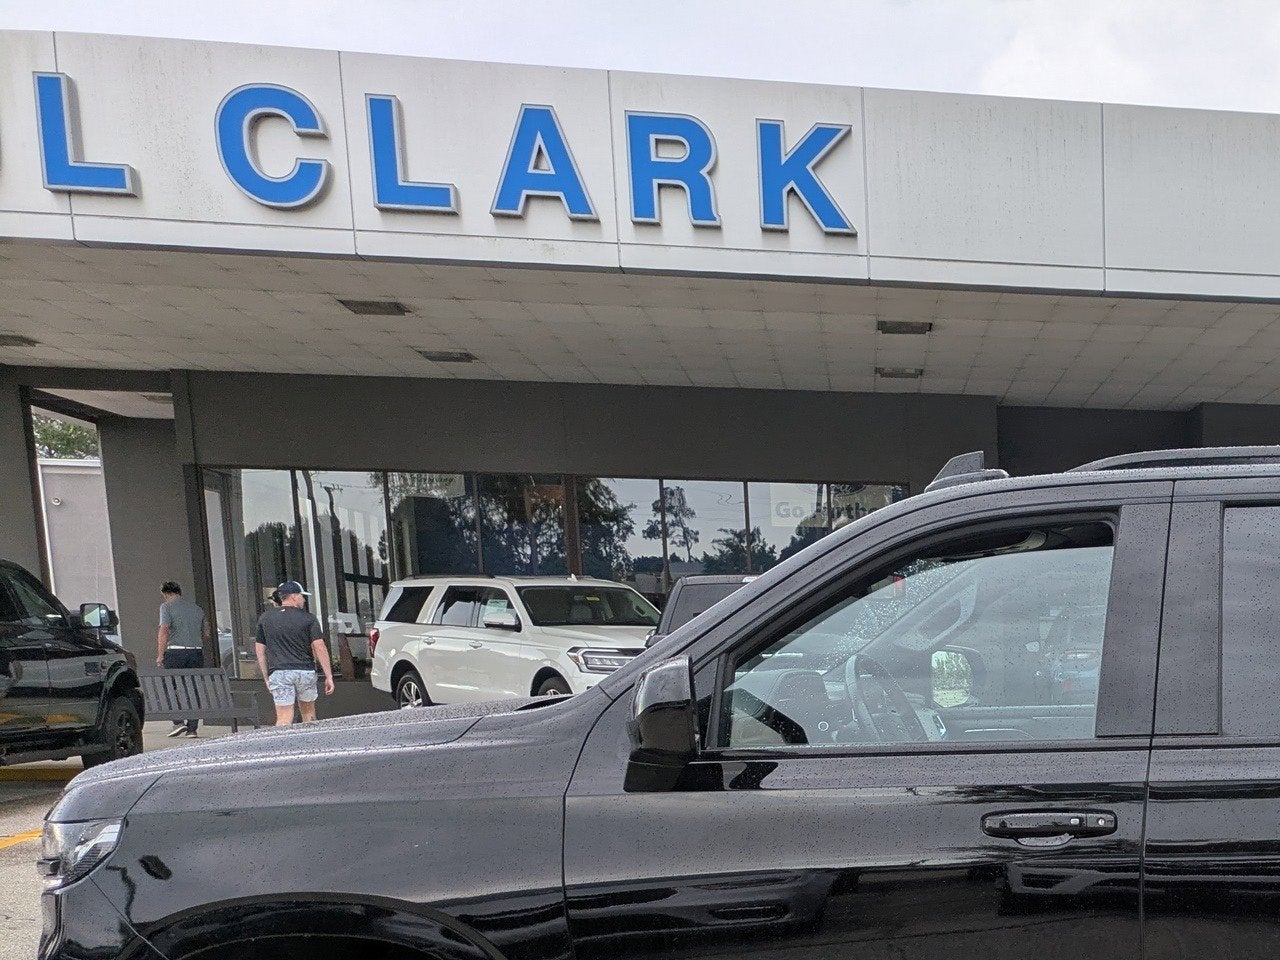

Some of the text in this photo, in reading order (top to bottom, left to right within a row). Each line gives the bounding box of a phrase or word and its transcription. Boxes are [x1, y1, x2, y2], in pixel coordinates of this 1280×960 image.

[32, 71, 858, 236] L CLARK
[774, 501, 805, 519] Go
